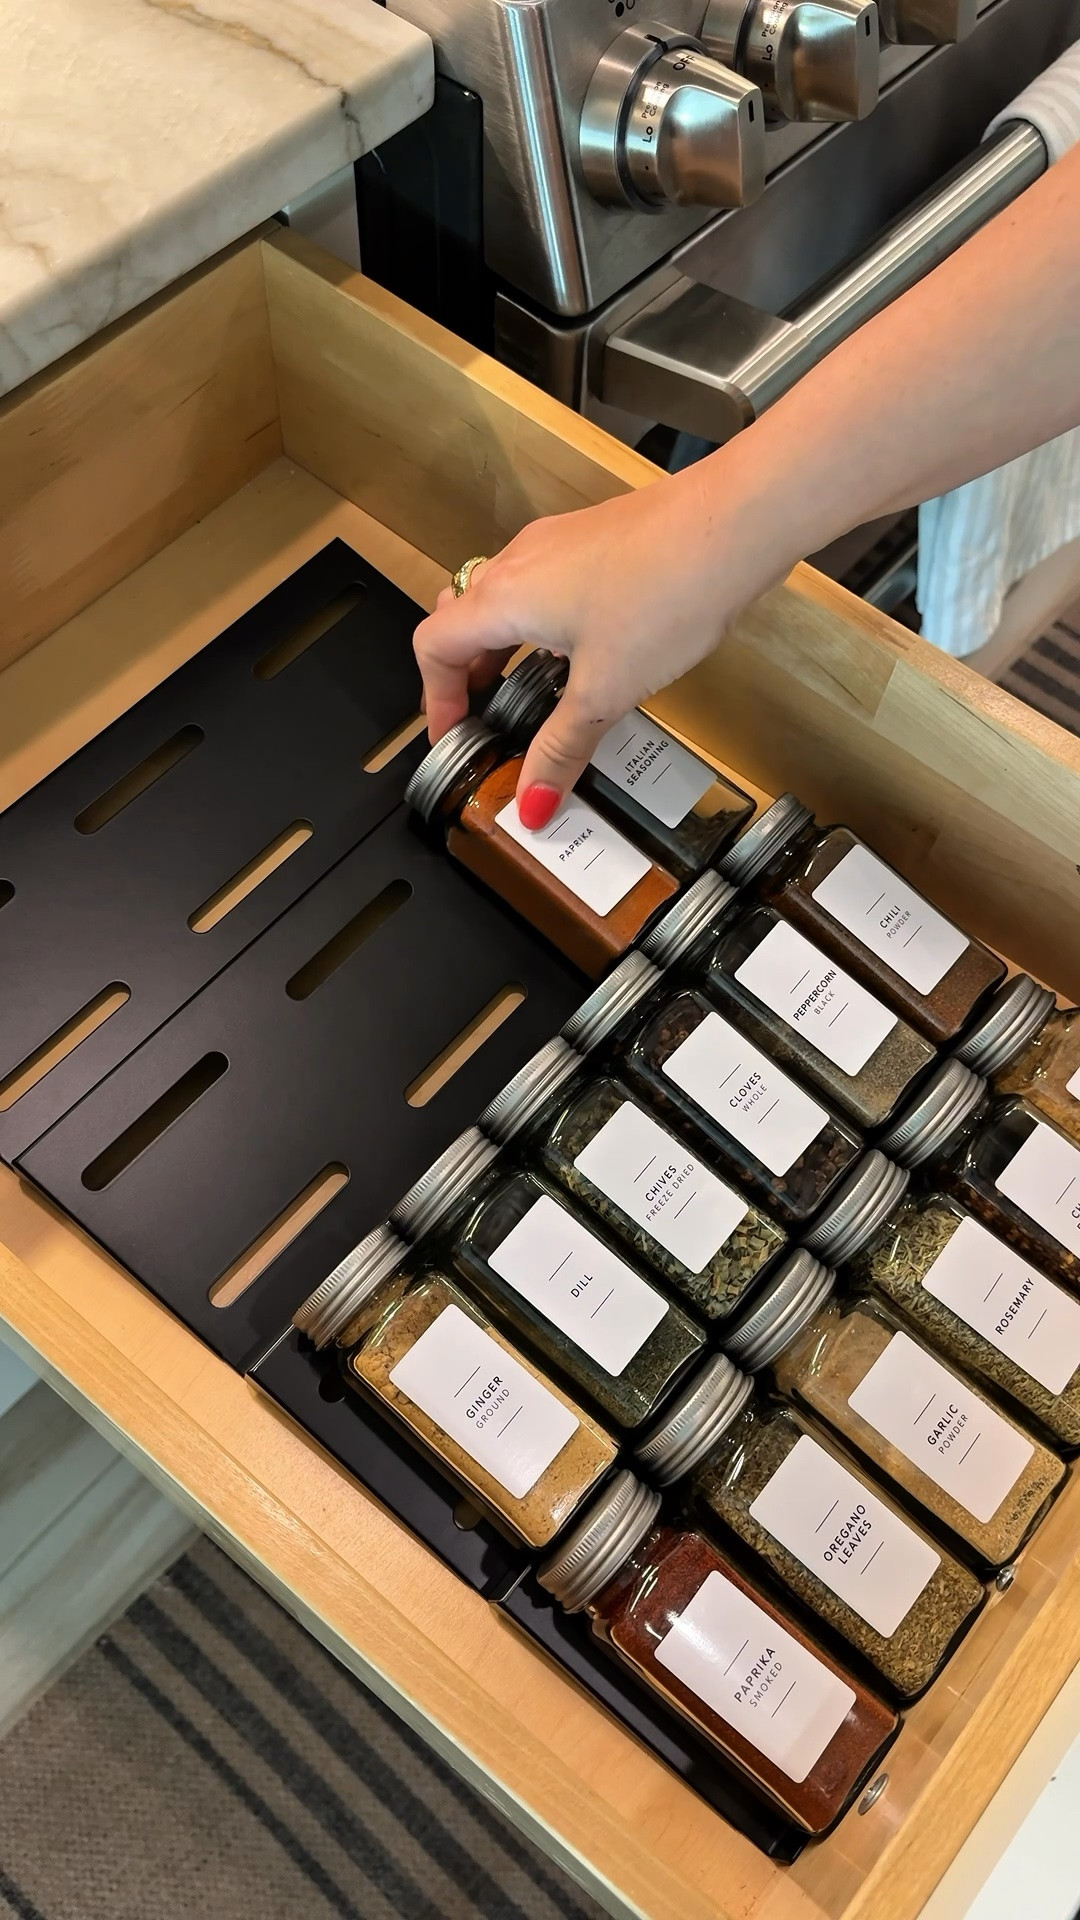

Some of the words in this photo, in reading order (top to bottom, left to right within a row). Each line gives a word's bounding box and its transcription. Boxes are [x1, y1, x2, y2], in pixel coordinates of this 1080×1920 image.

[672, 55, 695, 71] OFF
[641, 80, 662, 119] Preon
[648, 83, 670, 117] Cong
[624, 739, 655, 773] ITALIAN
[626, 740, 670, 786] SEASONING
[558, 828, 595, 862] PAPRIKA
[879, 905, 901, 929] CHILI
[886, 910, 912, 939] POWDER
[792, 969, 837, 1022] PEPPERCORN
[813, 990, 836, 1015] BLACK
[729, 1072, 762, 1108] CLOVES
[741, 1083, 768, 1112] WHOLE
[645, 1165, 677, 1202] CHIVES
[645, 1189, 674, 1222] FREEZE
[672, 1163, 695, 1190] DRIED
[570, 1275, 594, 1298] DILL
[994, 1277, 1034, 1336] ROSEMARY
[465, 1376, 504, 1419] GINGER
[475, 1388, 510, 1429] GROUND
[927, 1404, 959, 1446] GARLIC
[937, 1414, 968, 1455] POWDER
[823, 1504, 866, 1562] OREGANO
[837, 1519, 872, 1565] LEAVES
[733, 1648, 776, 1703] PAPRIKA
[749, 1662, 783, 1708] SMOKED
